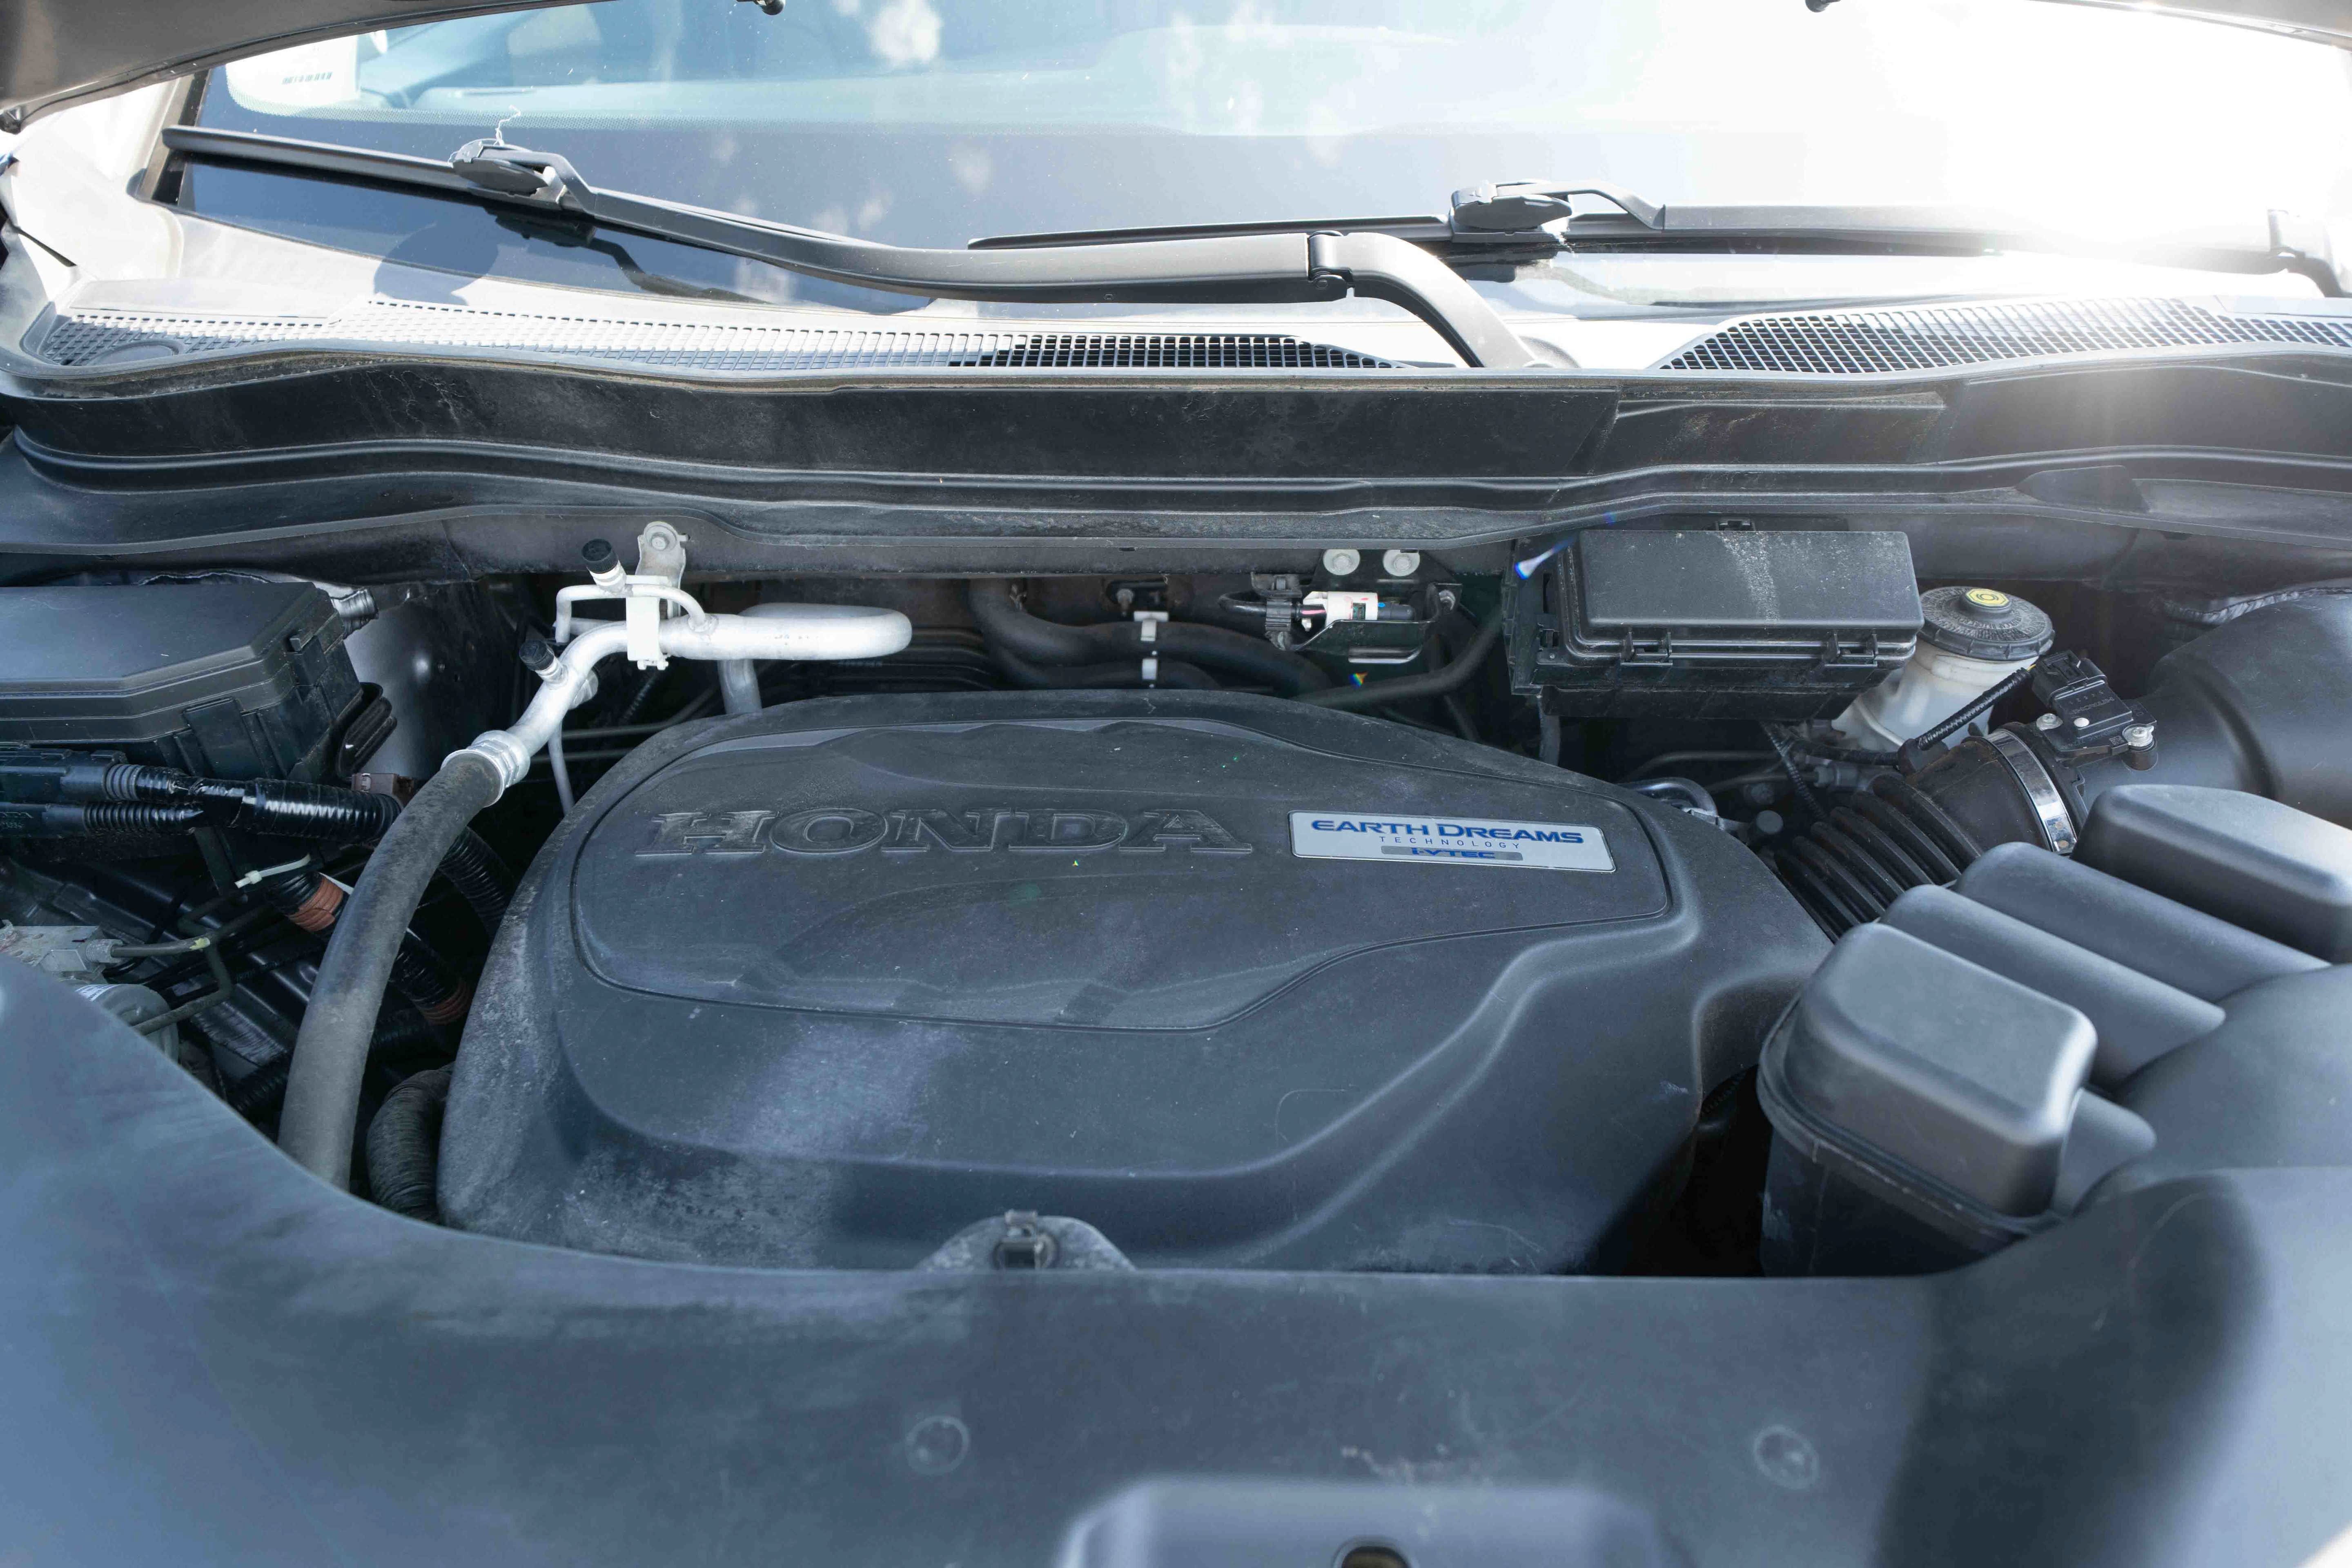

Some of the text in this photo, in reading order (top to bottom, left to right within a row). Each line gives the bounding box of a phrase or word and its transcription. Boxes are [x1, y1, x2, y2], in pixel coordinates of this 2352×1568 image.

[634, 807, 1252, 856] HONDA
[1311, 820, 1584, 844] EARTH DREAMS
[1379, 836, 1519, 849] TECHNOLOGY
[1411, 847, 1496, 858] i-VTEC
